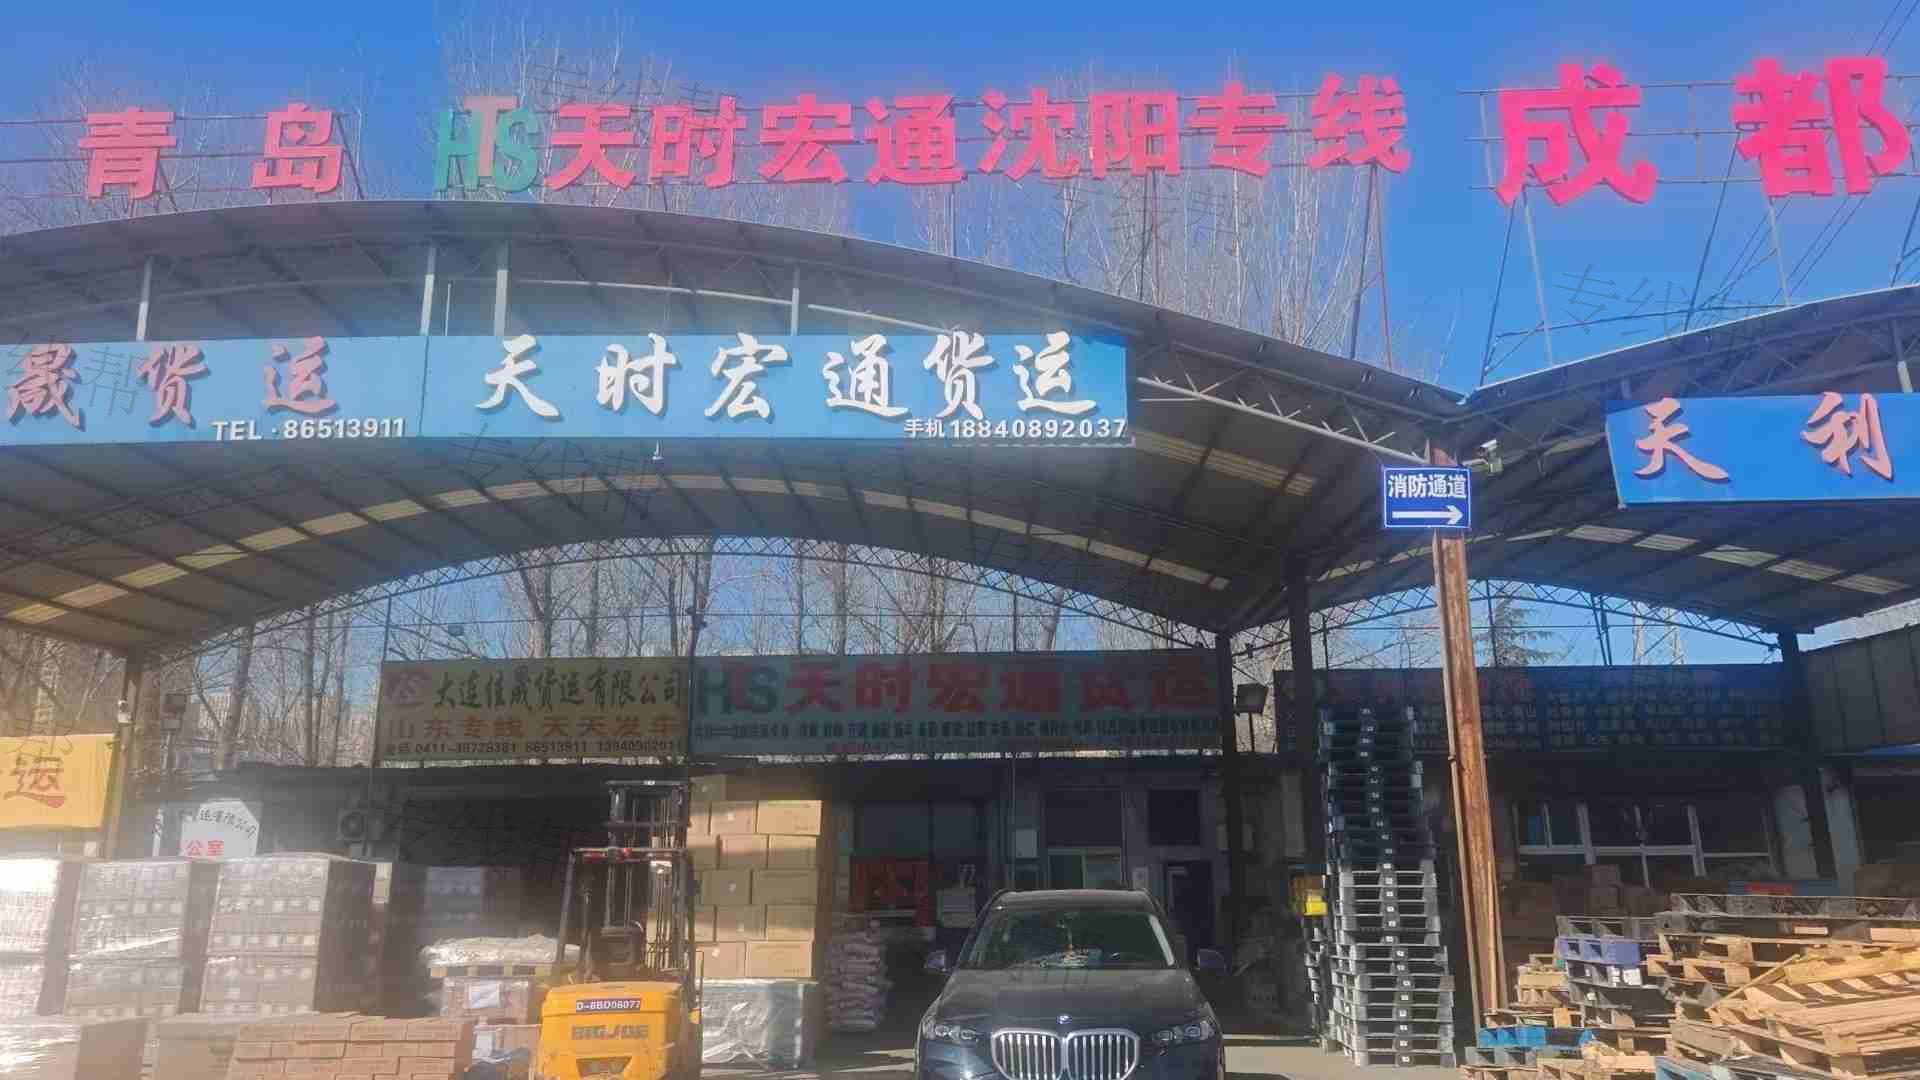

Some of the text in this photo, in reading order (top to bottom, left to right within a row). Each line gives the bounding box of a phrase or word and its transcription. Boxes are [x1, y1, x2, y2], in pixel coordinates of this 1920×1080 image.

[79, 102, 347, 200] 青岛
[1496, 56, 1912, 206] 成都
[476, 329, 1099, 421] 天时宏通货运
[1634, 389, 1895, 481] 天利
[1387, 473, 1467, 498] 消防通道
